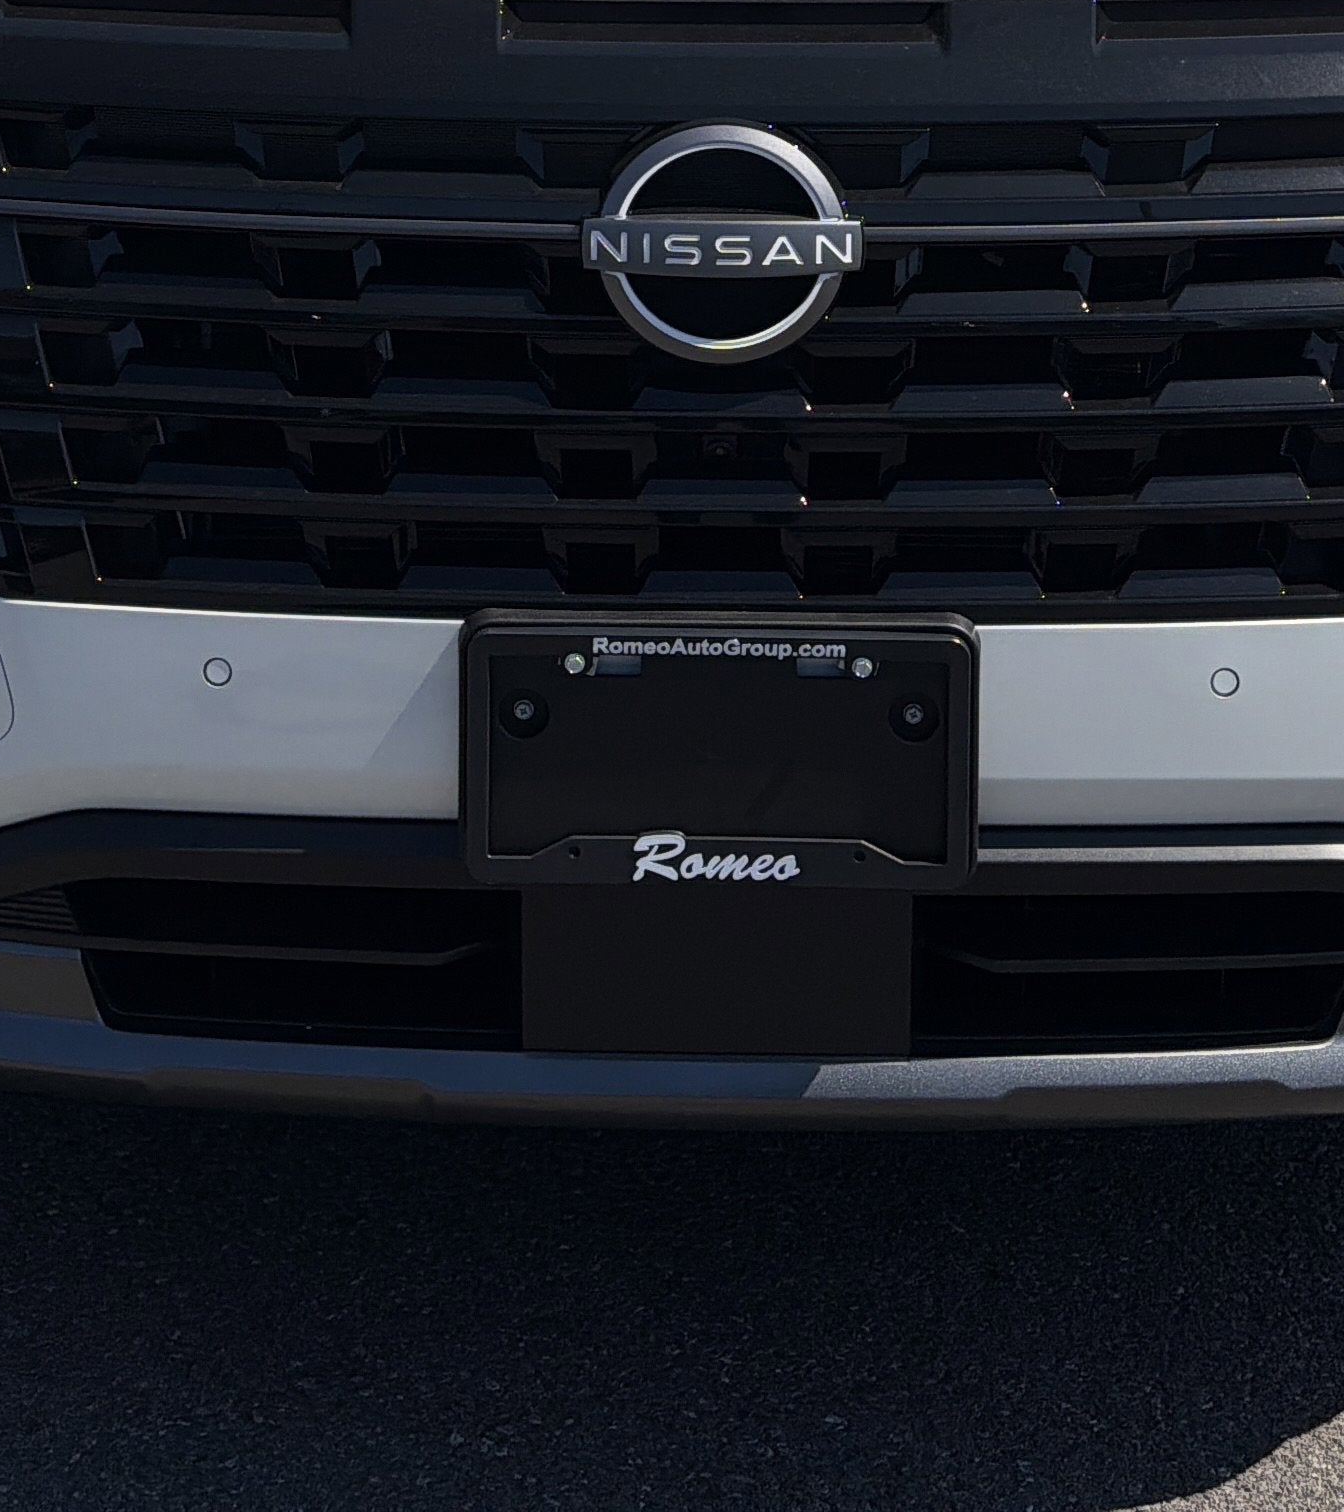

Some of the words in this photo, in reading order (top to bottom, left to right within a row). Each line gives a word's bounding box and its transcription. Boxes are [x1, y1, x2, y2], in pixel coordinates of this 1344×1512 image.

[589, 229, 854, 267] NISSAN
[592, 635, 847, 660] RomeoAutoGroup.com
[631, 832, 801, 882] Romeo
